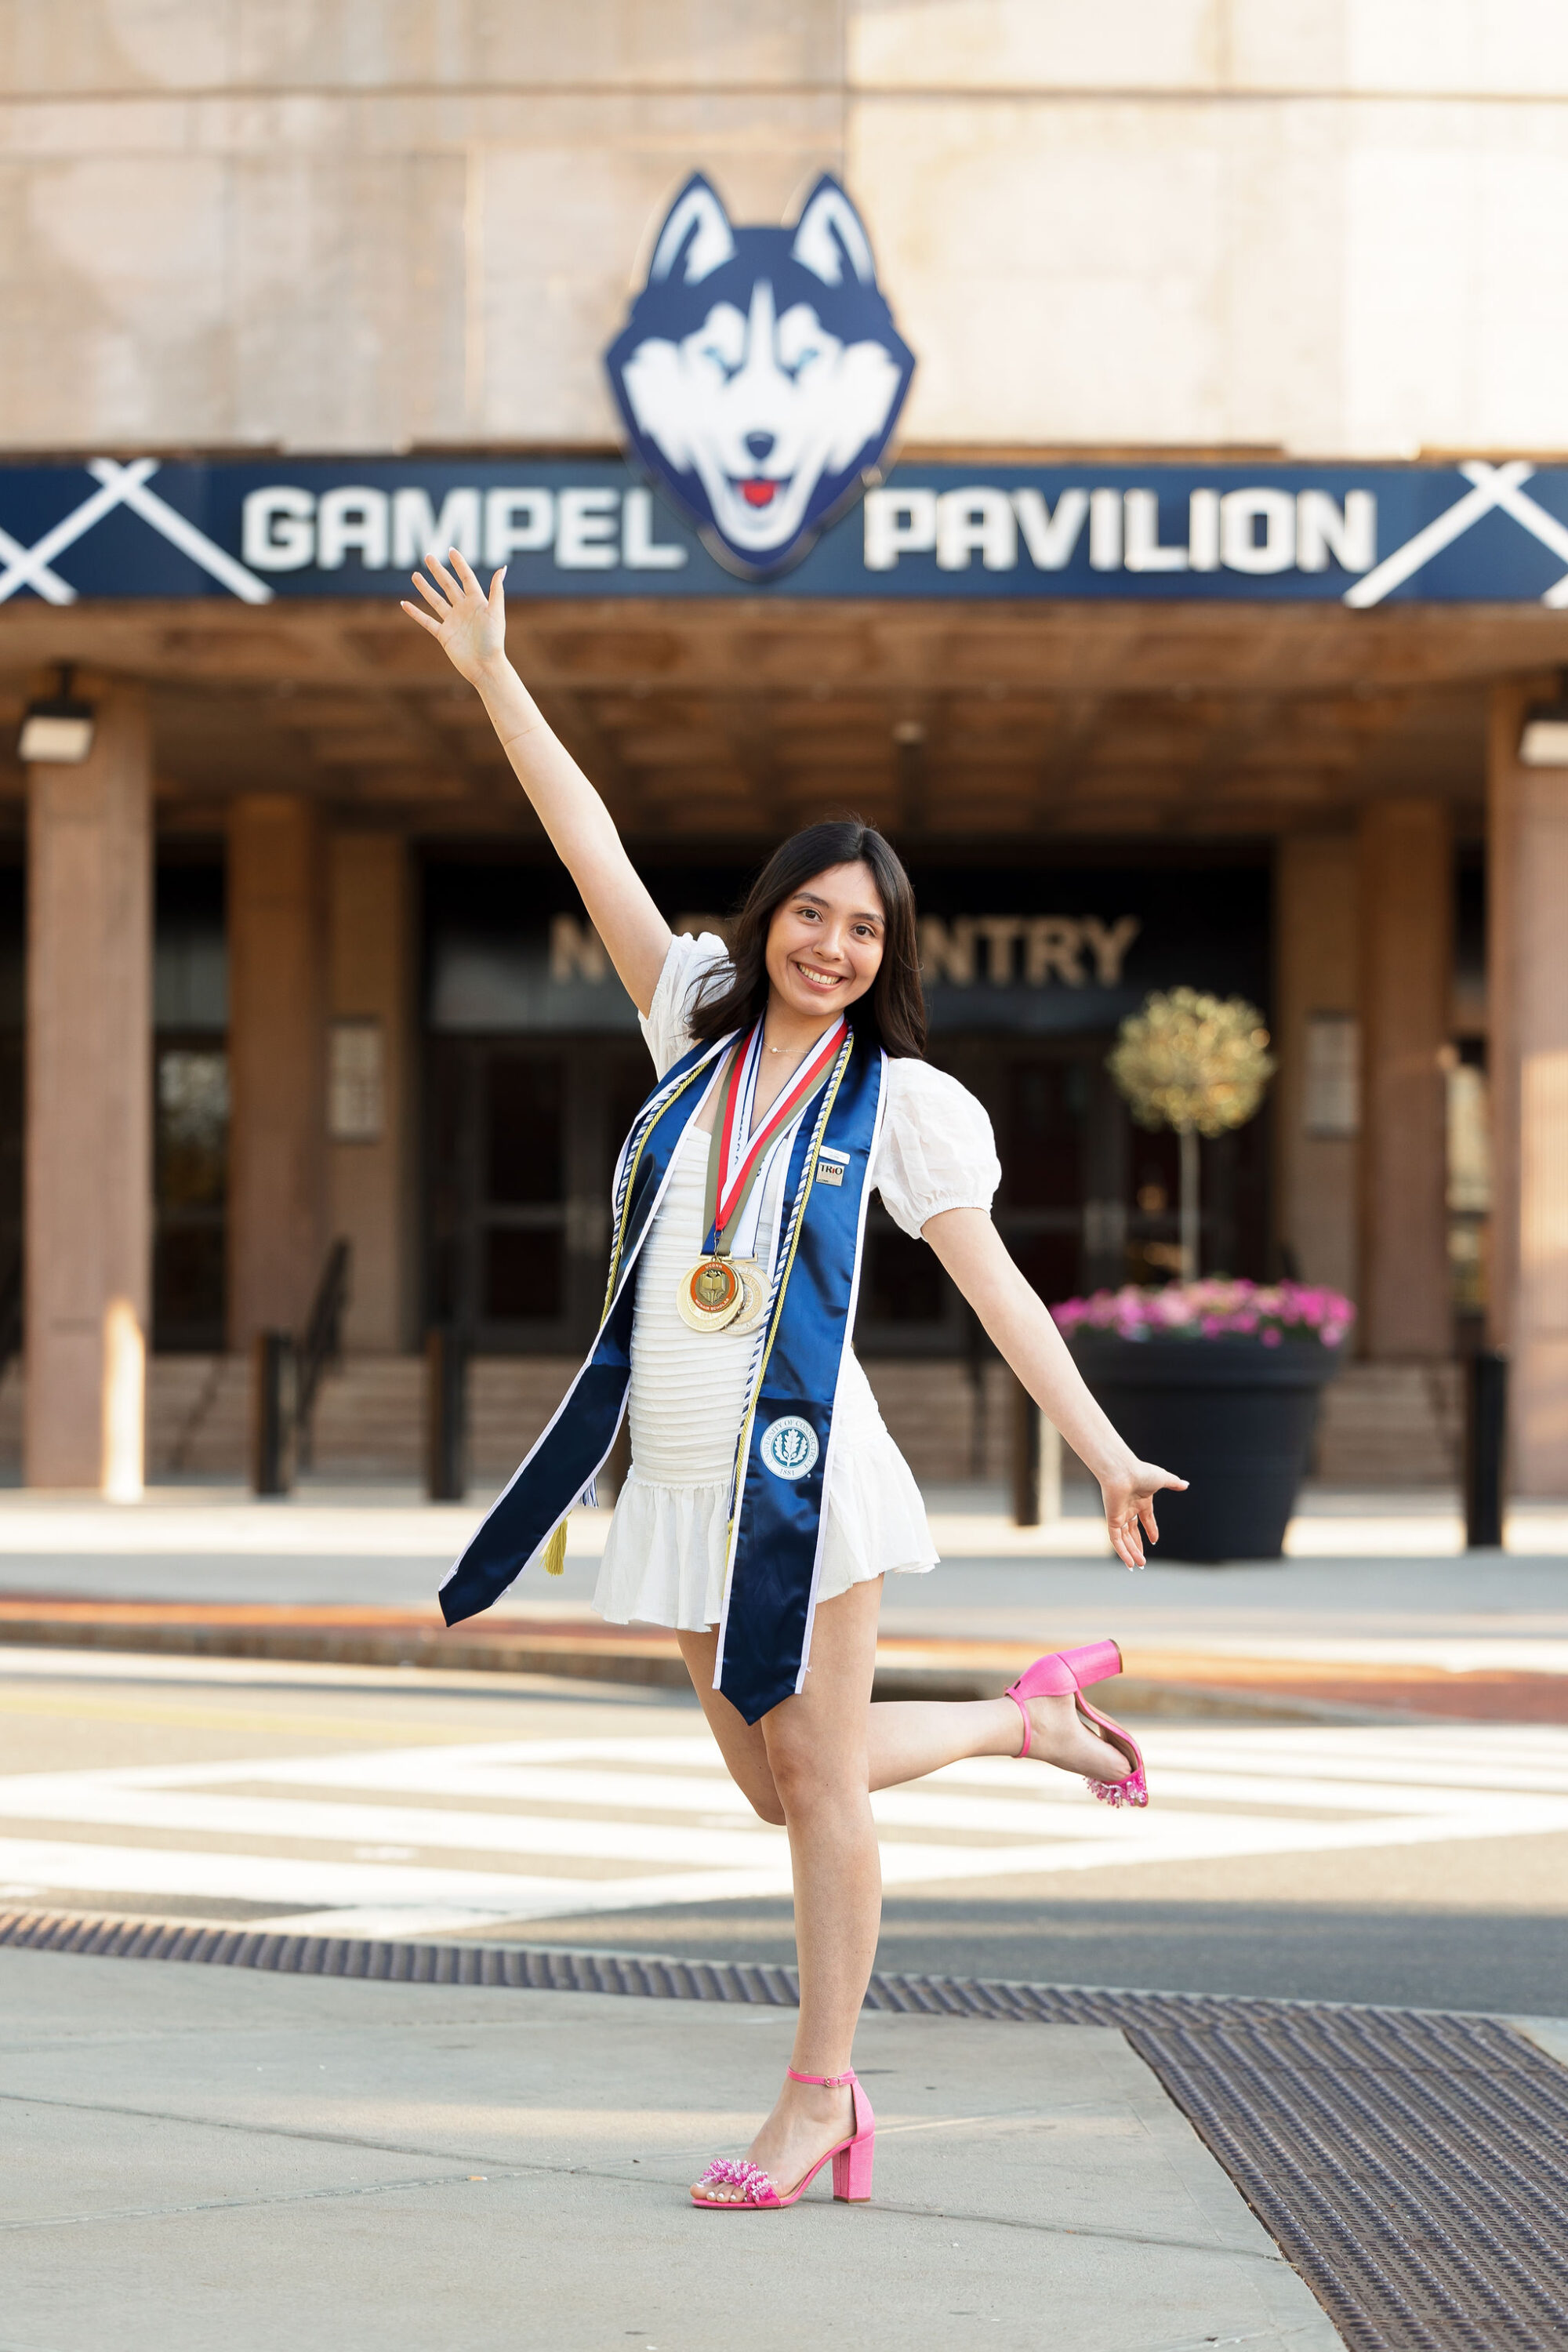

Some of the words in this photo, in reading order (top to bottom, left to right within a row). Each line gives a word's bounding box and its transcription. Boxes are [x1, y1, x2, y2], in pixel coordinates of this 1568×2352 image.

[242, 486, 687, 572] GAMPEL
[864, 487, 1377, 573] PAVILION
[916, 913, 1142, 986] NTRY
[710, 1298, 730, 1311] SCHOLAR
[763, 1421, 782, 1465] UNIVERSITY
[795, 1420, 817, 1470] CONNECTICUT
